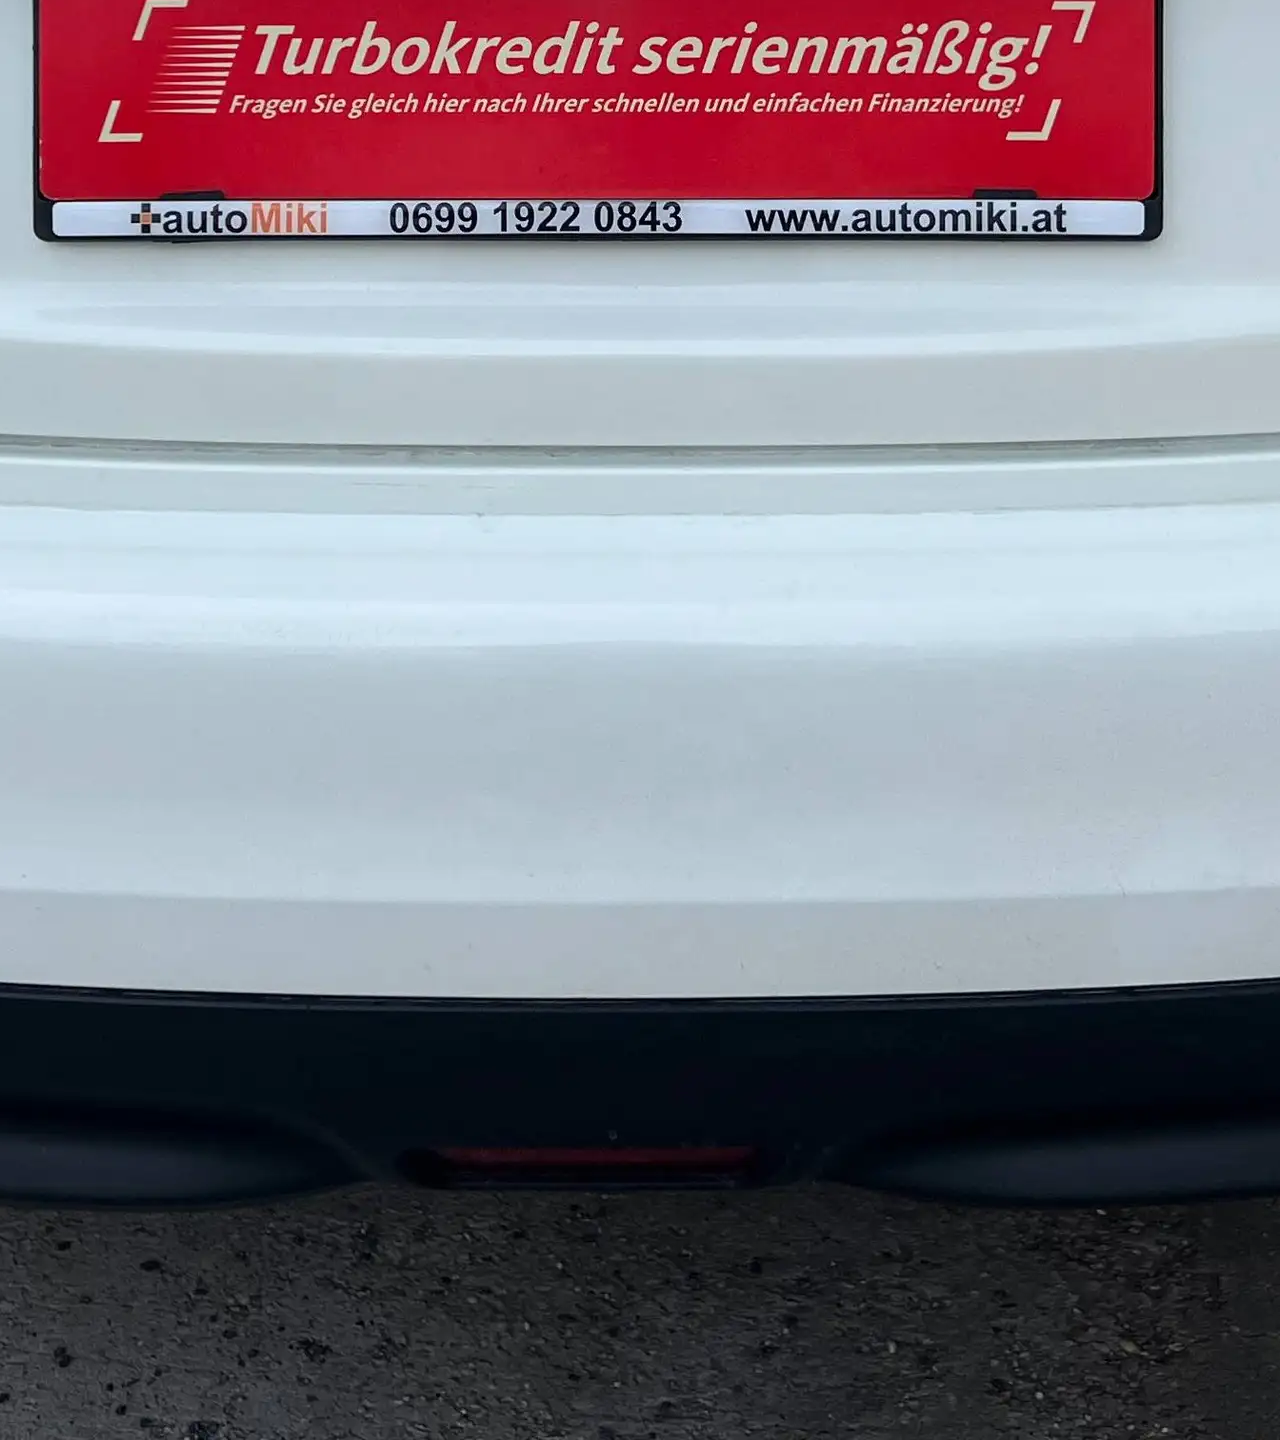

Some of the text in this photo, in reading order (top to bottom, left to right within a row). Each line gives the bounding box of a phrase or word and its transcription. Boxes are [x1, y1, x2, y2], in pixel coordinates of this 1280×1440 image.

[255, 20, 1053, 92] Turbokredit serienmäßig!
[228, 92, 1025, 120] Fragen Sie gleich hier nach Ihrer schnellen und einfachen Finanzierung!
[162, 201, 328, 234] autoMiki
[388, 201, 684, 234] 0699 1922 0843
[744, 201, 1068, 233] www.automiki.at
